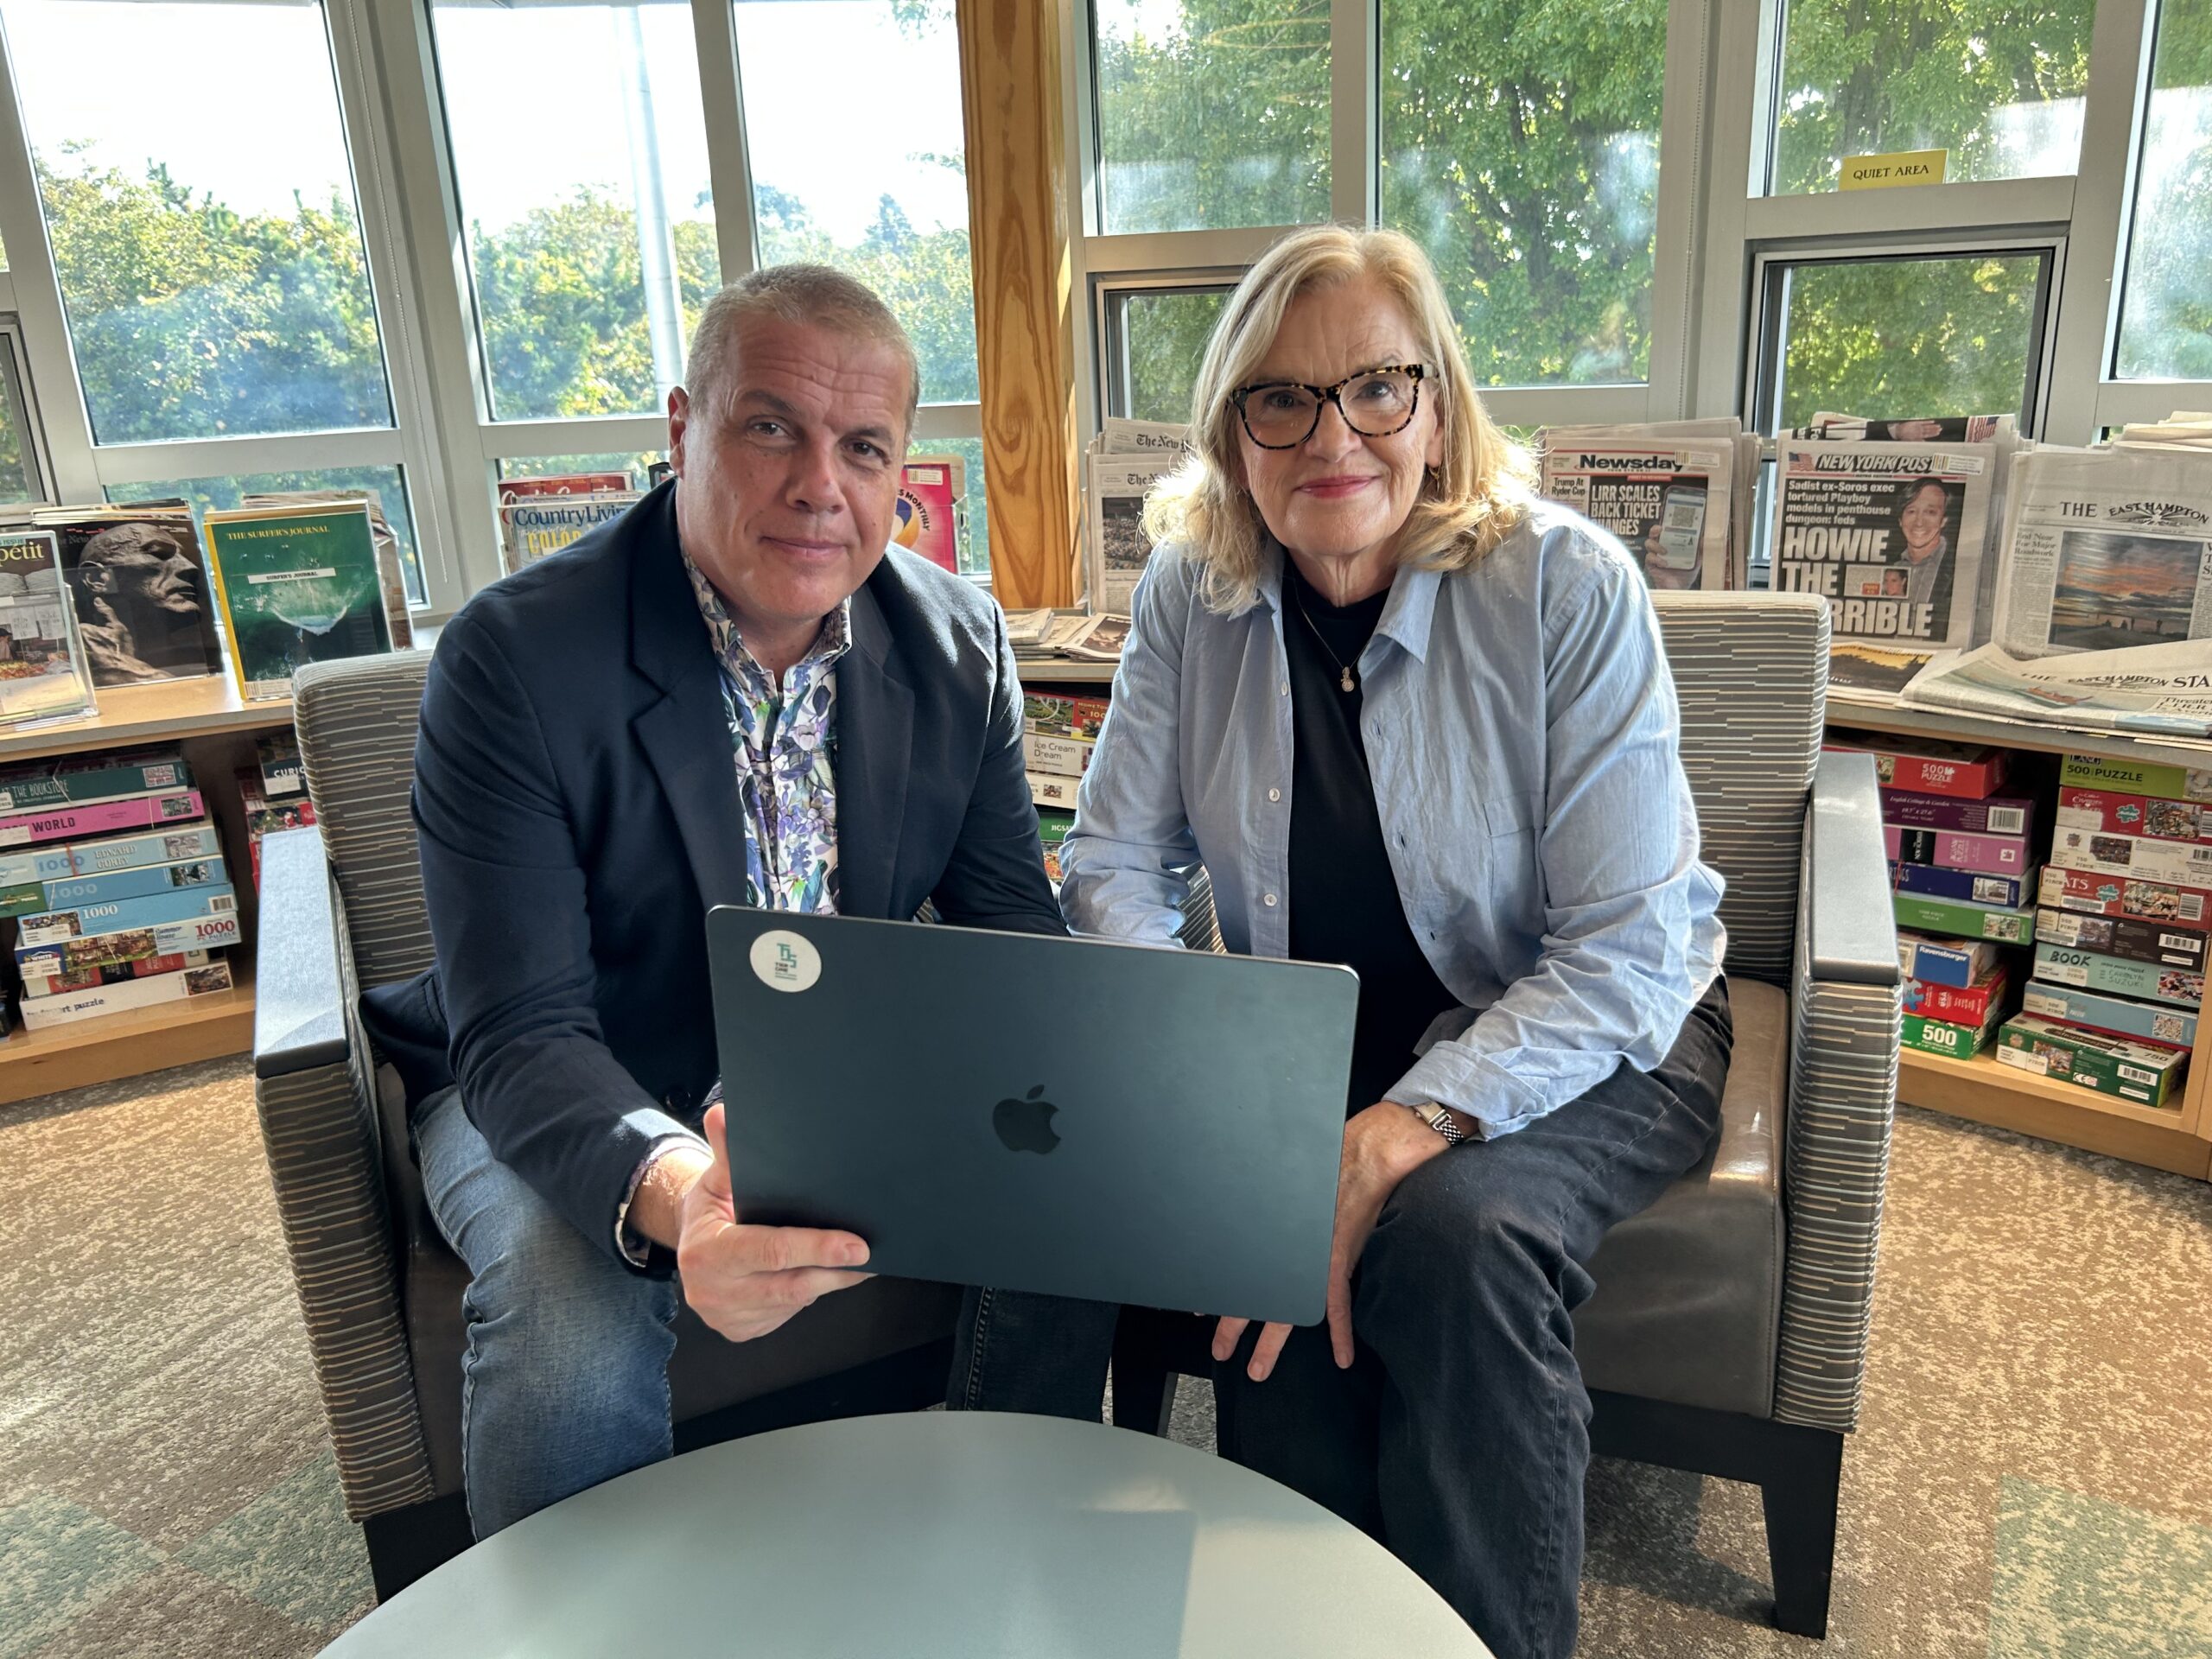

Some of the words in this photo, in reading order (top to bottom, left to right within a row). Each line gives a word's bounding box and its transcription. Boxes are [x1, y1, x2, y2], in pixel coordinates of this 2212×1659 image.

[1853, 167, 1891, 180] QUIET
[1894, 164, 1929, 177] AREA
[1136, 434, 1156, 448] The
[1158, 435, 1179, 449] New
[1580, 454, 1683, 473] Newsday
[1816, 454, 1855, 472] NEW
[1854, 454, 1897, 473] YORK
[1895, 455, 1933, 474] POS
[1127, 473, 1147, 486] The
[1554, 477, 1575, 486] Trump
[1576, 477, 1584, 486] At
[1788, 480, 1820, 491] Sadist
[1821, 482, 1868, 492] ex-Soros
[1551, 486, 1571, 496] Ryder
[1572, 486, 1586, 496] Cup
[1591, 485, 1617, 501] LIRR
[1618, 485, 1661, 502] SCALES
[1787, 493, 1828, 502] tortured
[1830, 493, 1872, 505] Playboy
[906, 492, 930, 531] MONTHLY
[1591, 502, 1621, 518] BACK
[1624, 503, 1662, 518] TICKET
[1786, 503, 1822, 513] models
[1825, 504, 1834, 513] in
[1836, 505, 1891, 516] penthouse
[2060, 501, 2098, 518] THE
[2108, 502, 2141, 517] EAST
[2145, 502, 2209, 524] HAMPTON
[1785, 513, 1831, 524] dungeon:
[1833, 514, 1856, 524] feds
[247, 528, 289, 539] SURFER'S
[289, 524, 330, 537] JOURNAL
[1782, 526, 1890, 562] HOWIE
[2031, 540, 2056, 550] Major
[1781, 562, 1839, 596] THE
[1828, 600, 1934, 638] RRIBLE
[2105, 674, 2170, 687] HAMPTON
[2171, 674, 2212, 689] STA
[1033, 740, 1046, 749] Ice
[1048, 742, 1076, 753] Cream
[1033, 749, 1062, 760] Dream
[1922, 763, 1944, 774] 500
[2066, 765, 2090, 775] 500
[2094, 767, 2144, 782] PUZZLE
[1921, 772, 1954, 782] PUZZLE
[11, 784, 28, 798] THE
[29, 779, 69, 797] BOOKSTORE
[31, 817, 76, 833] WORLD
[94, 844, 137, 859] EDWARD
[38, 855, 85, 872] 1000
[57, 883, 98, 898] 000
[2064, 876, 2088, 890] ATS
[82, 904, 118, 919] 1000
[195, 919, 236, 937] 1000
[1919, 945, 1969, 962] Ravensburger
[2049, 950, 2092, 967] BOOK
[73, 998, 105, 1012] puzzle
[1922, 1024, 1958, 1046] 500
[2144, 1052, 2169, 1062] 750
